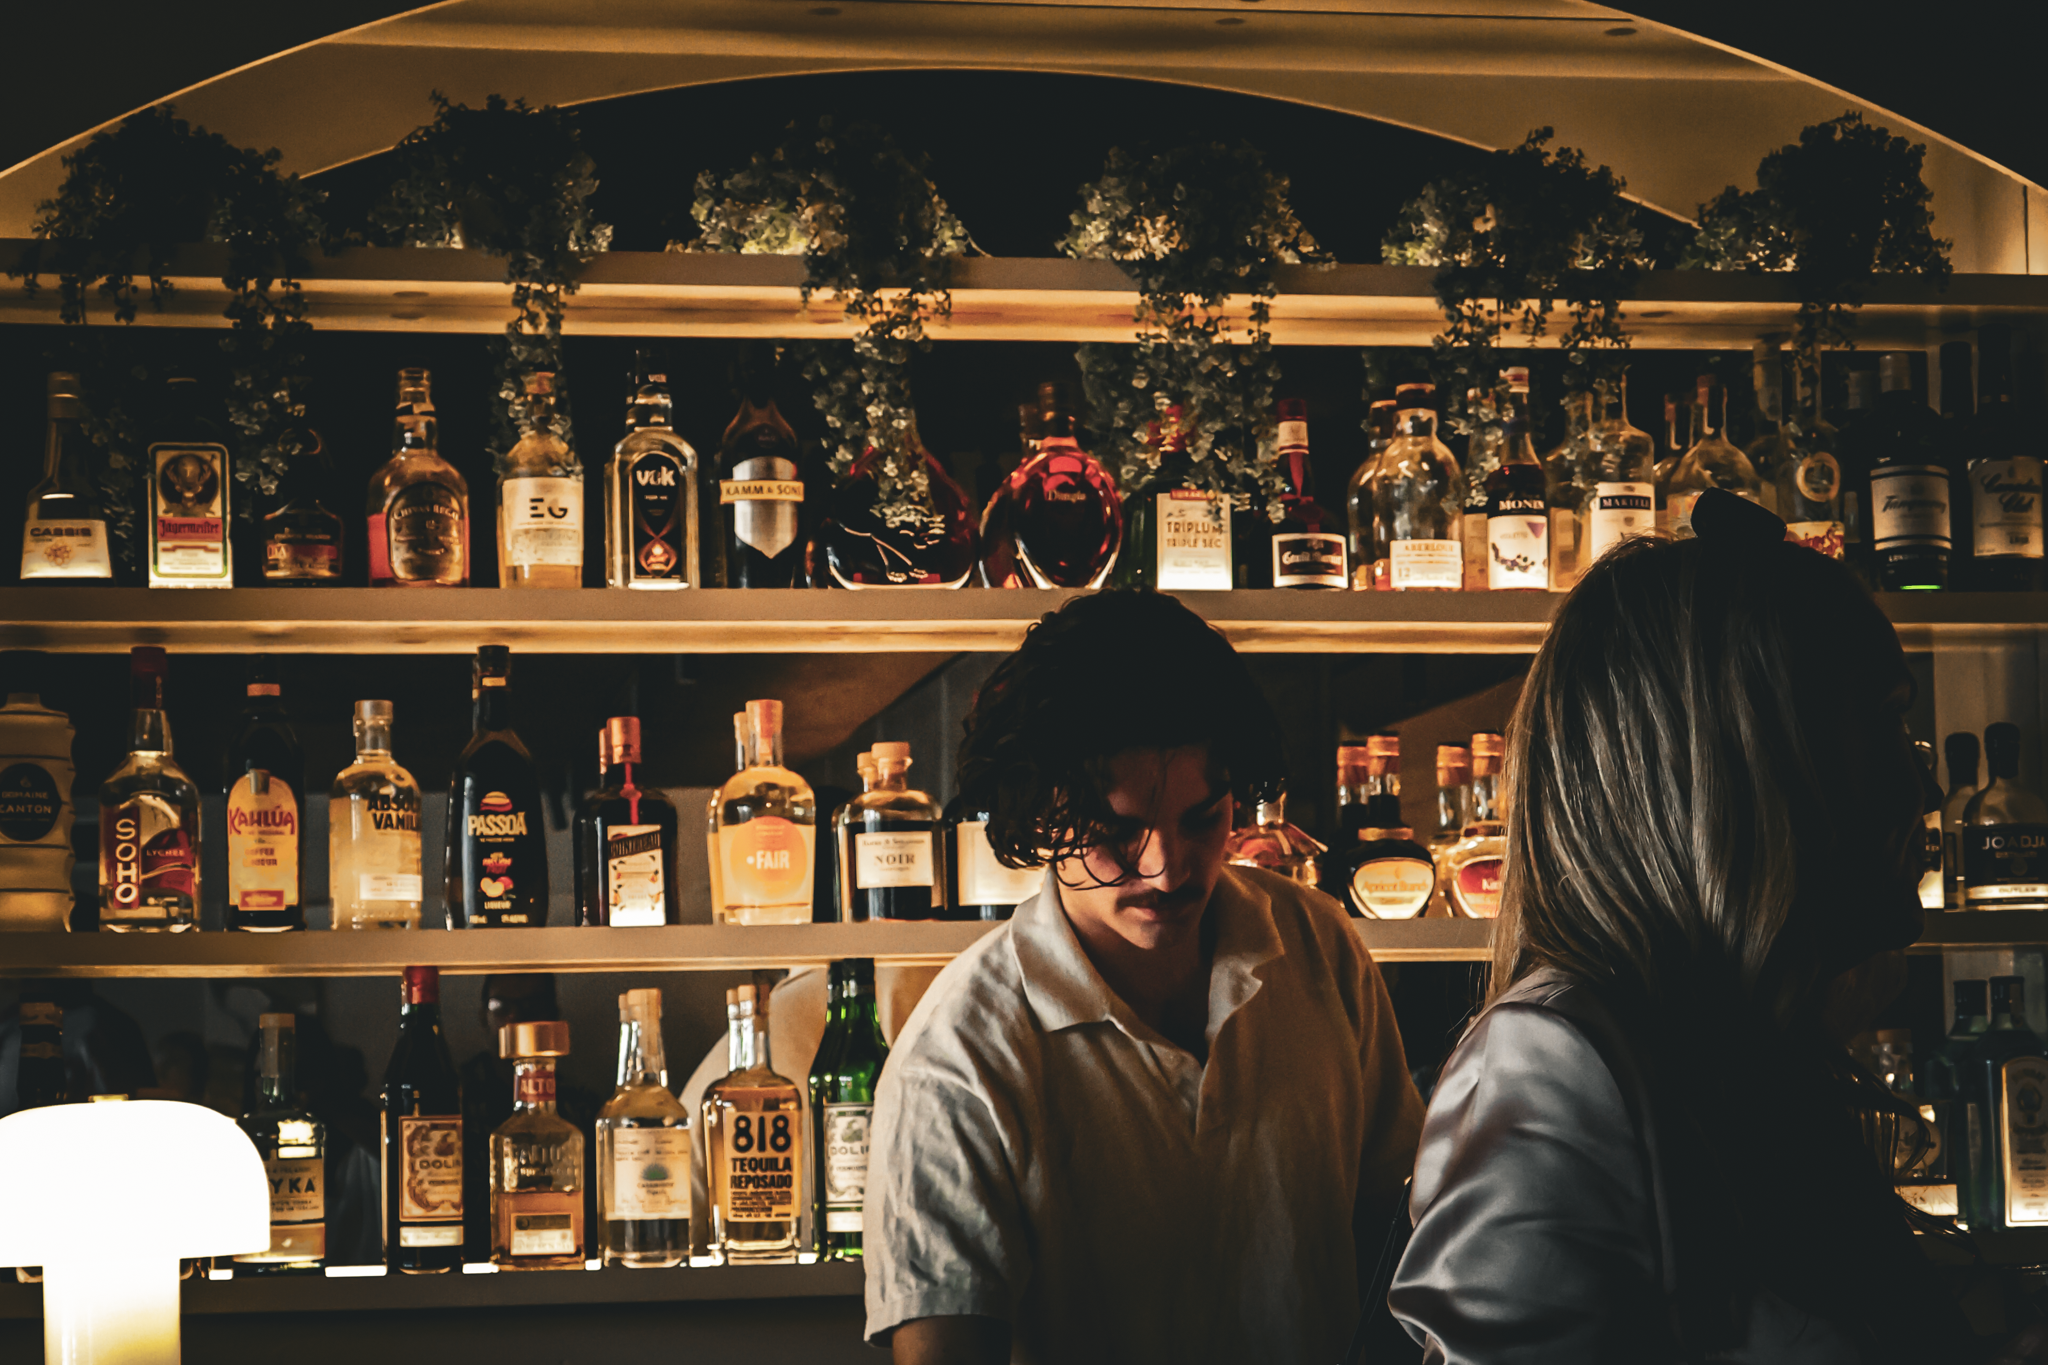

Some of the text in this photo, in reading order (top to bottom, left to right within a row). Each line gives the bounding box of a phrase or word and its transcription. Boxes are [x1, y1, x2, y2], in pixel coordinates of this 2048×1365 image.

[530, 498, 568, 519] EG
[115, 818, 138, 904] SOHO
[756, 850, 791, 871] FAIR
[875, 854, 915, 866] NOIR
[733, 1114, 791, 1153] 818
[731, 1157, 792, 1172] TEQUILA
[268, 1177, 315, 1194] YKA
[730, 1174, 792, 1188] REPOSADO
